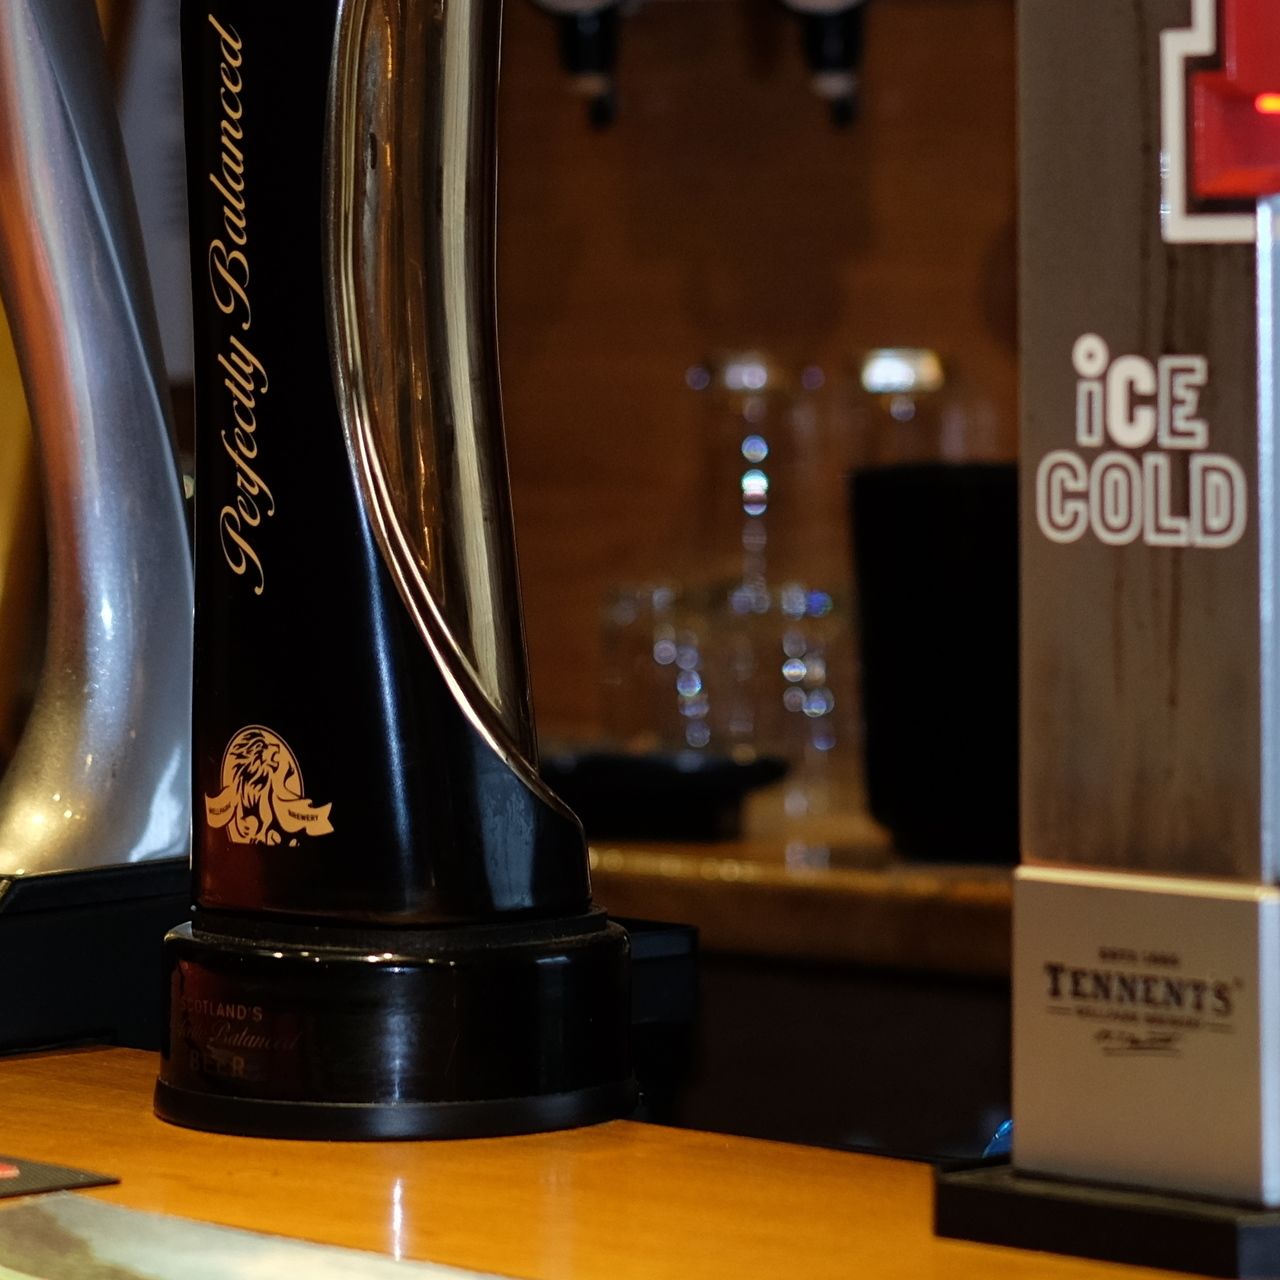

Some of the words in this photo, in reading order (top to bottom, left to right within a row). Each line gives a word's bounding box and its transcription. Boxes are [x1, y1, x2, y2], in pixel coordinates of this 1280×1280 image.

[207, 13, 252, 331] Balanced
[219, 334, 275, 596] Perfectly
[1036, 449, 1248, 549] COLD
